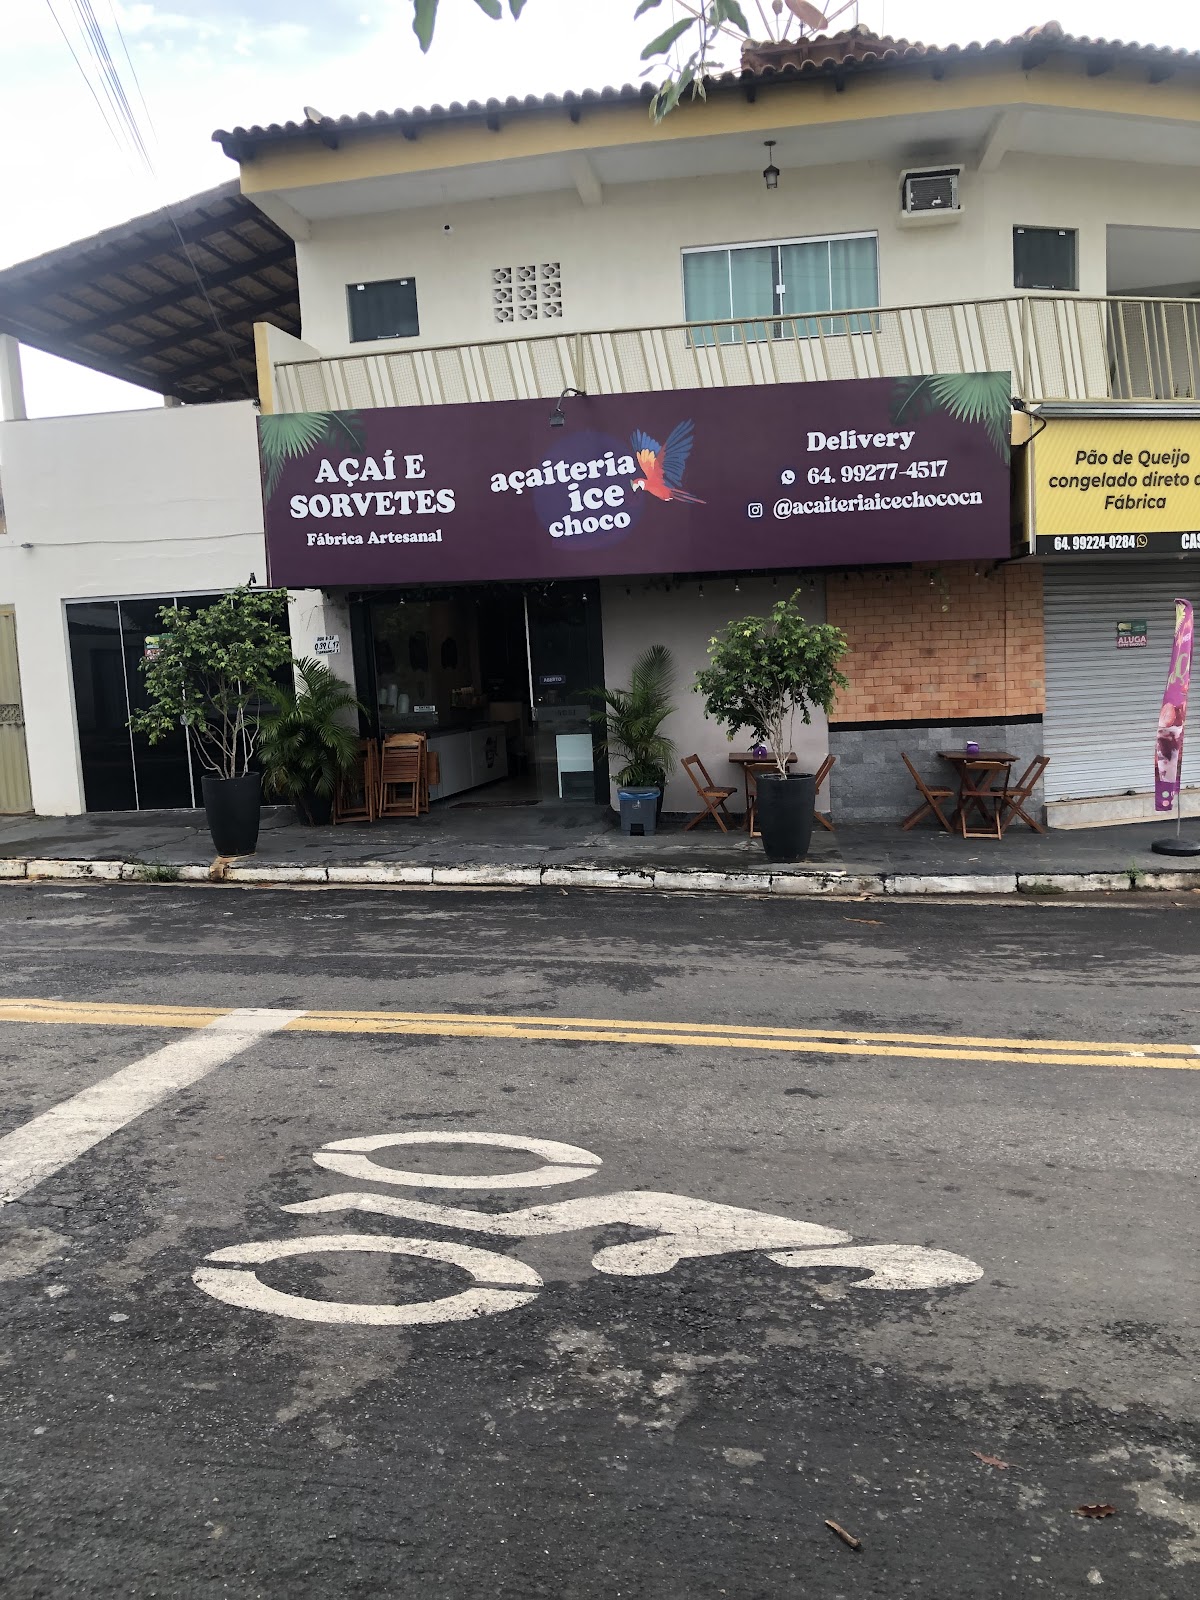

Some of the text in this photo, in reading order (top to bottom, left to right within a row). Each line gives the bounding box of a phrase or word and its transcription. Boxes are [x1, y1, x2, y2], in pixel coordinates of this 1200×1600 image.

[806, 430, 916, 452] Delivery
[314, 449, 426, 488] AÇAÍ E
[1075, 448, 1190, 468] Pão de Queijo
[490, 451, 637, 495] açaiteria
[807, 459, 949, 485] 64. 99277-4517
[1048, 471, 1138, 492] congelado
[1142, 470, 1190, 487] direto
[289, 488, 456, 519] SORVETES
[567, 482, 625, 513] ice
[773, 489, 983, 520] @acaiteriaicechococn
[1104, 494, 1167, 510] Fábrica
[548, 511, 631, 538] choco
[306, 528, 443, 546] Fábrica Artesanal
[1054, 534, 1136, 551] 64. 99224-0284
[1117, 635, 1147, 644] ALUGA
